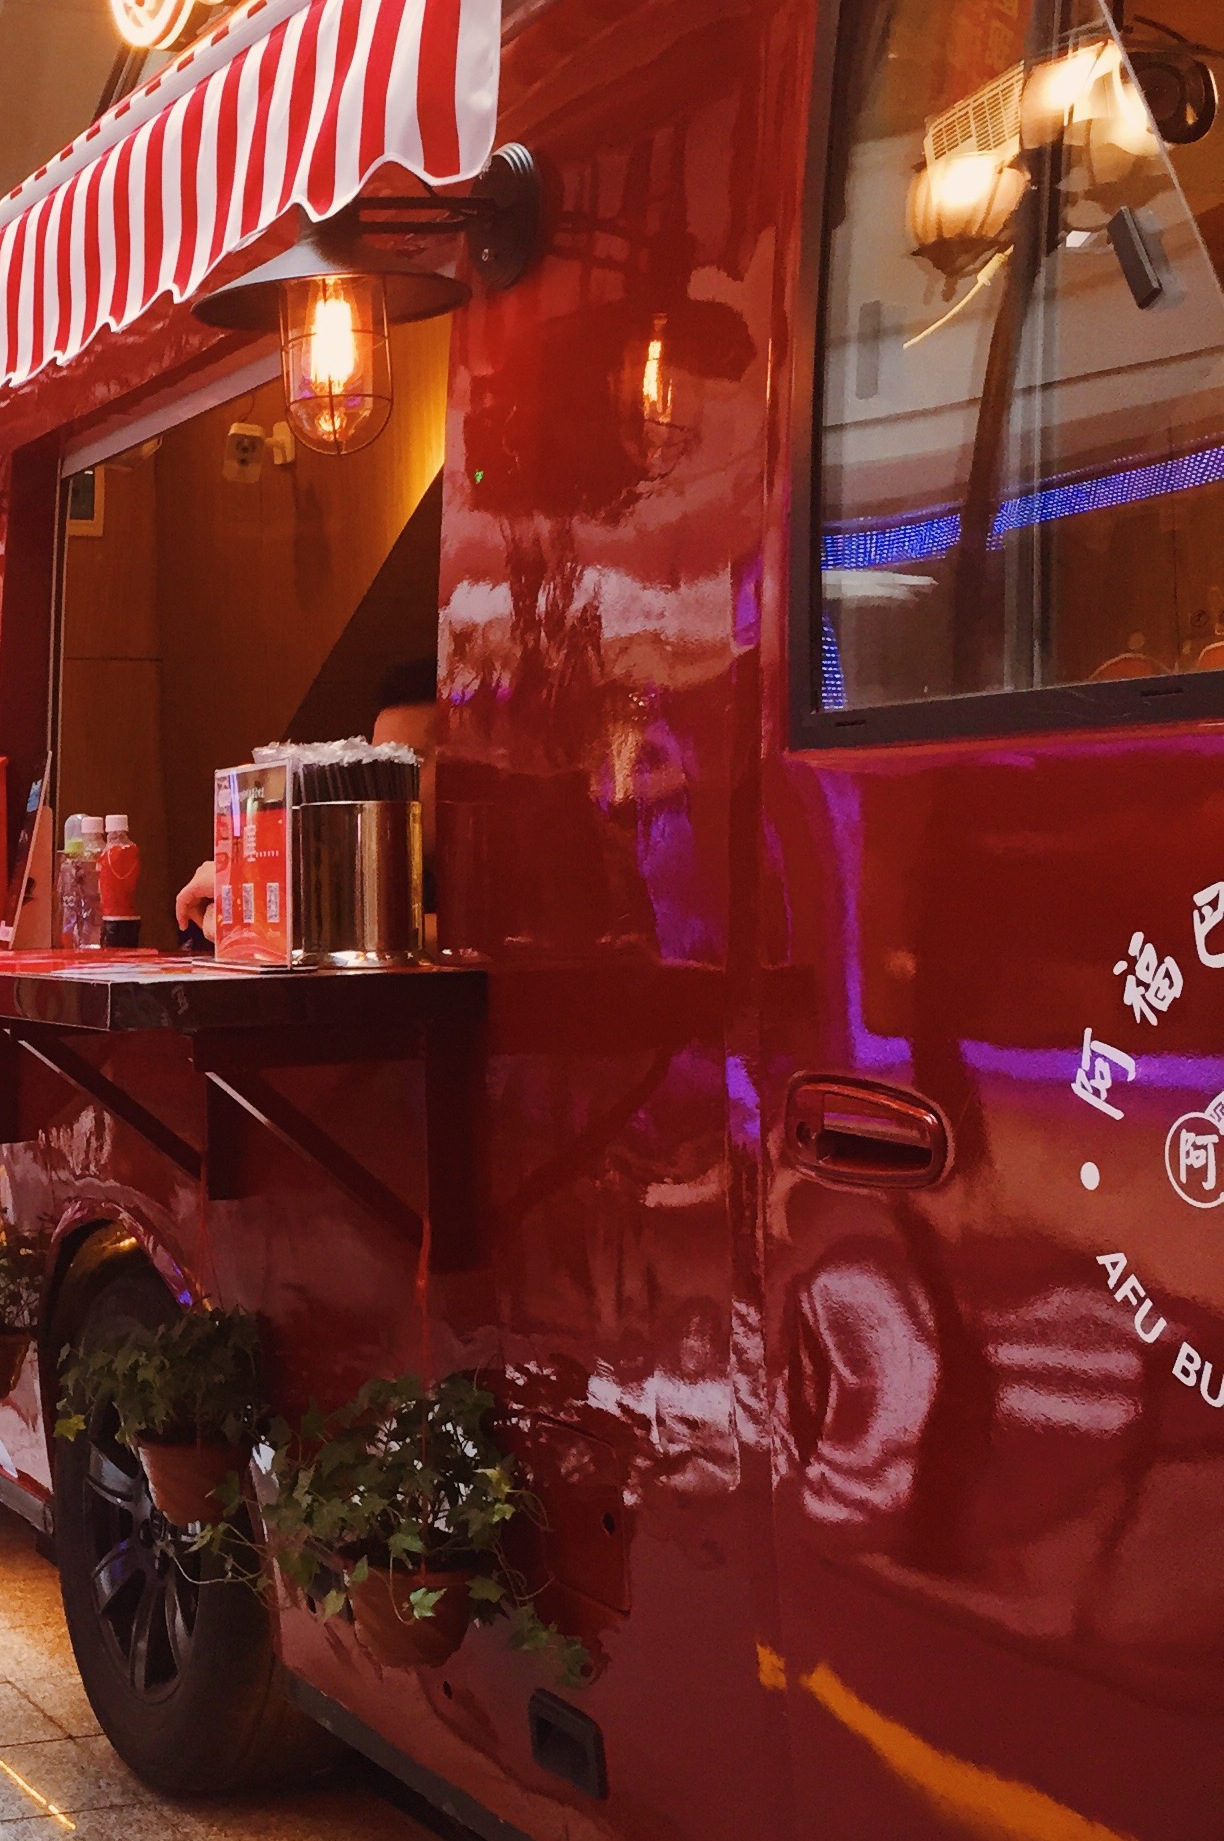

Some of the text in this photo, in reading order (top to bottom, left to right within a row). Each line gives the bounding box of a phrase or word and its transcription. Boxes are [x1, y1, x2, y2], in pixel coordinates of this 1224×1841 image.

[1179, 1128, 1220, 1191] 阿
[1095, 1252, 1224, 1408] AFU BU
